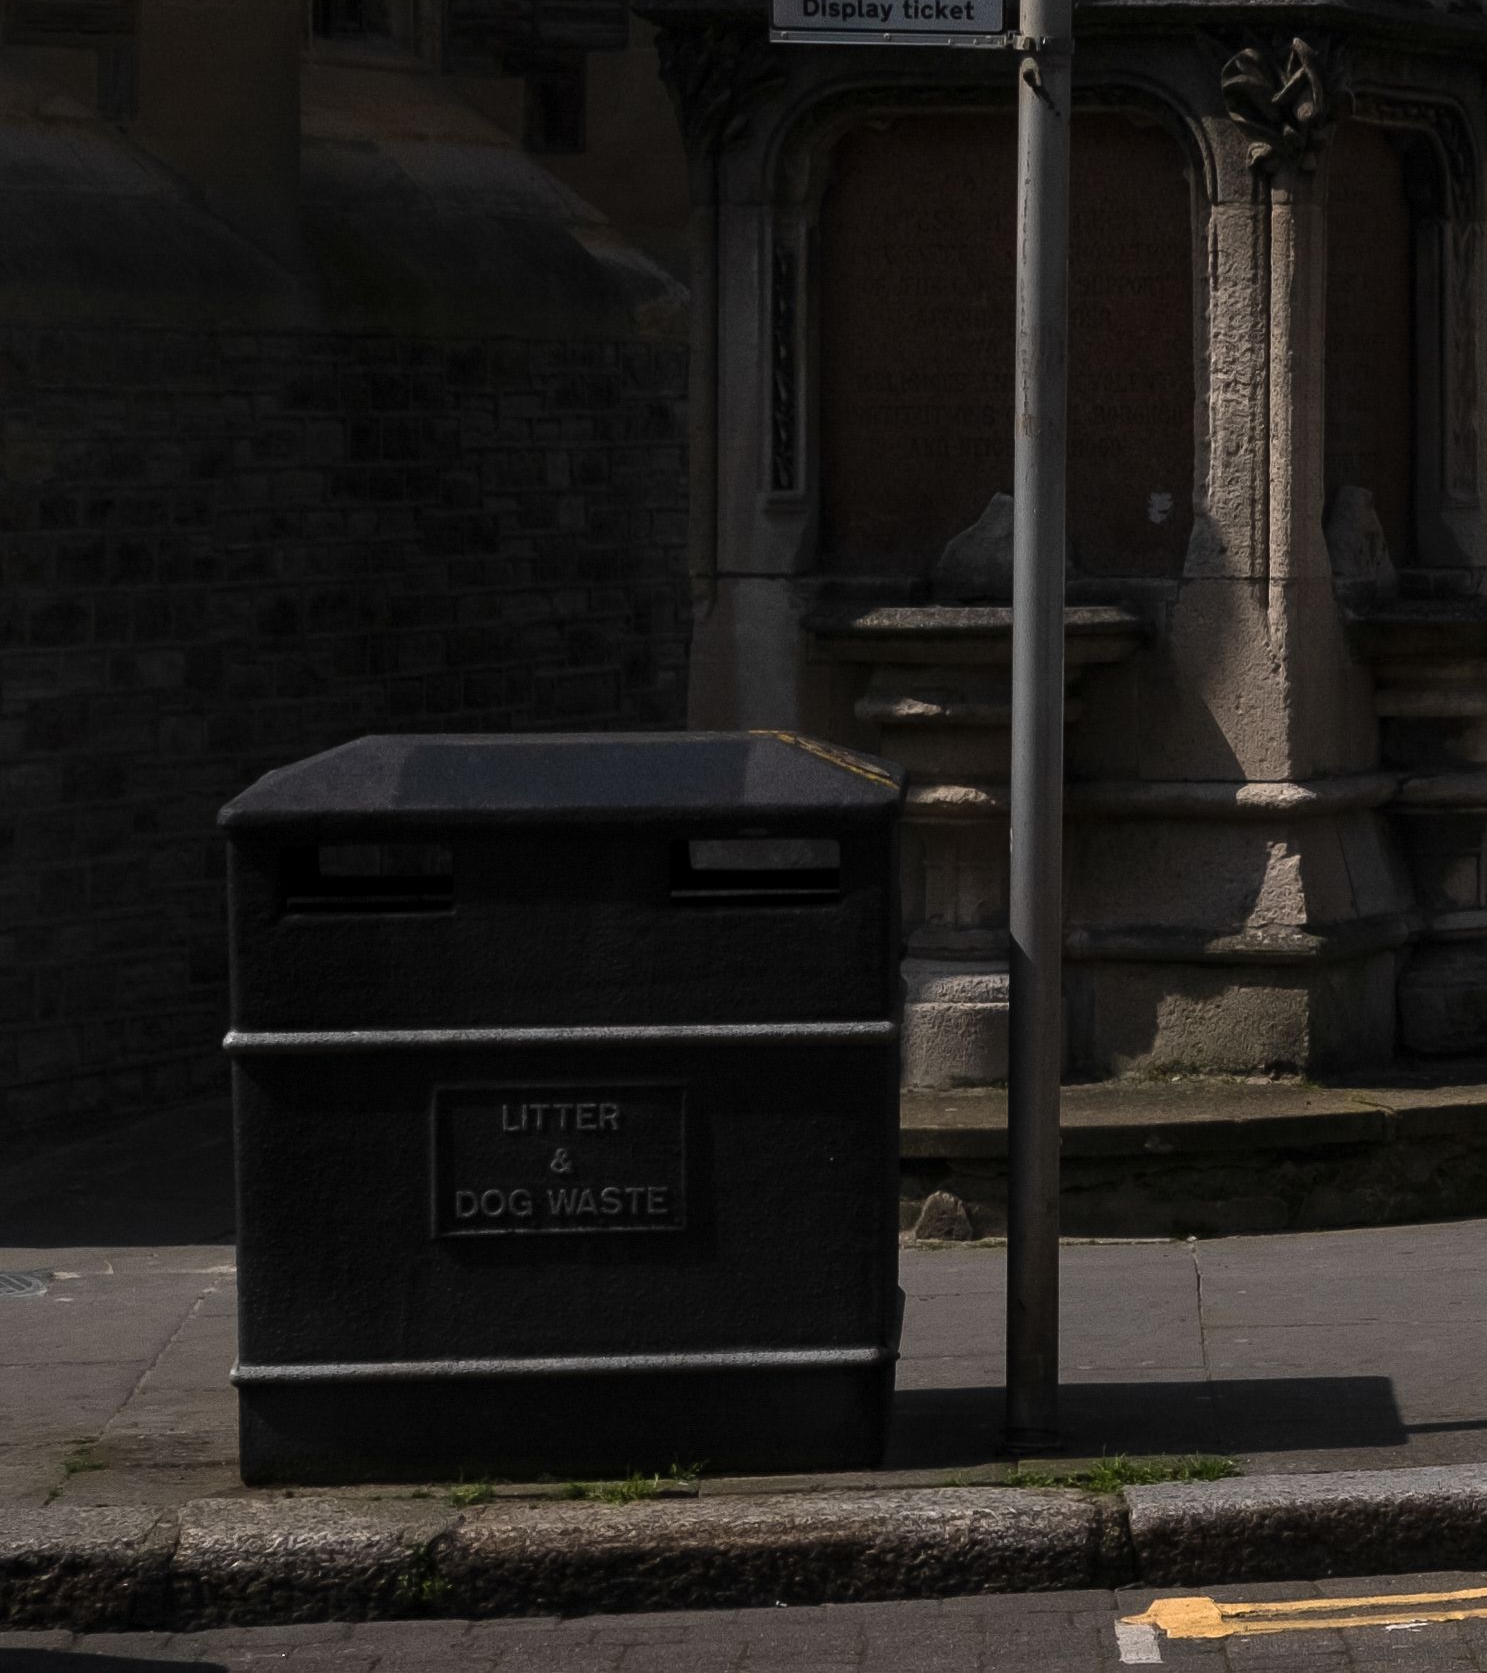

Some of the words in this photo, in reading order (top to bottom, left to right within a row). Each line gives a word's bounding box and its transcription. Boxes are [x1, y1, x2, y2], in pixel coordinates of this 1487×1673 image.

[902, 0, 975, 21] ticket
[501, 1102, 621, 1132] LITTER
[549, 1147, 574, 1173] &
[455, 1188, 534, 1218] DOG
[547, 1185, 670, 1217] WASTE
